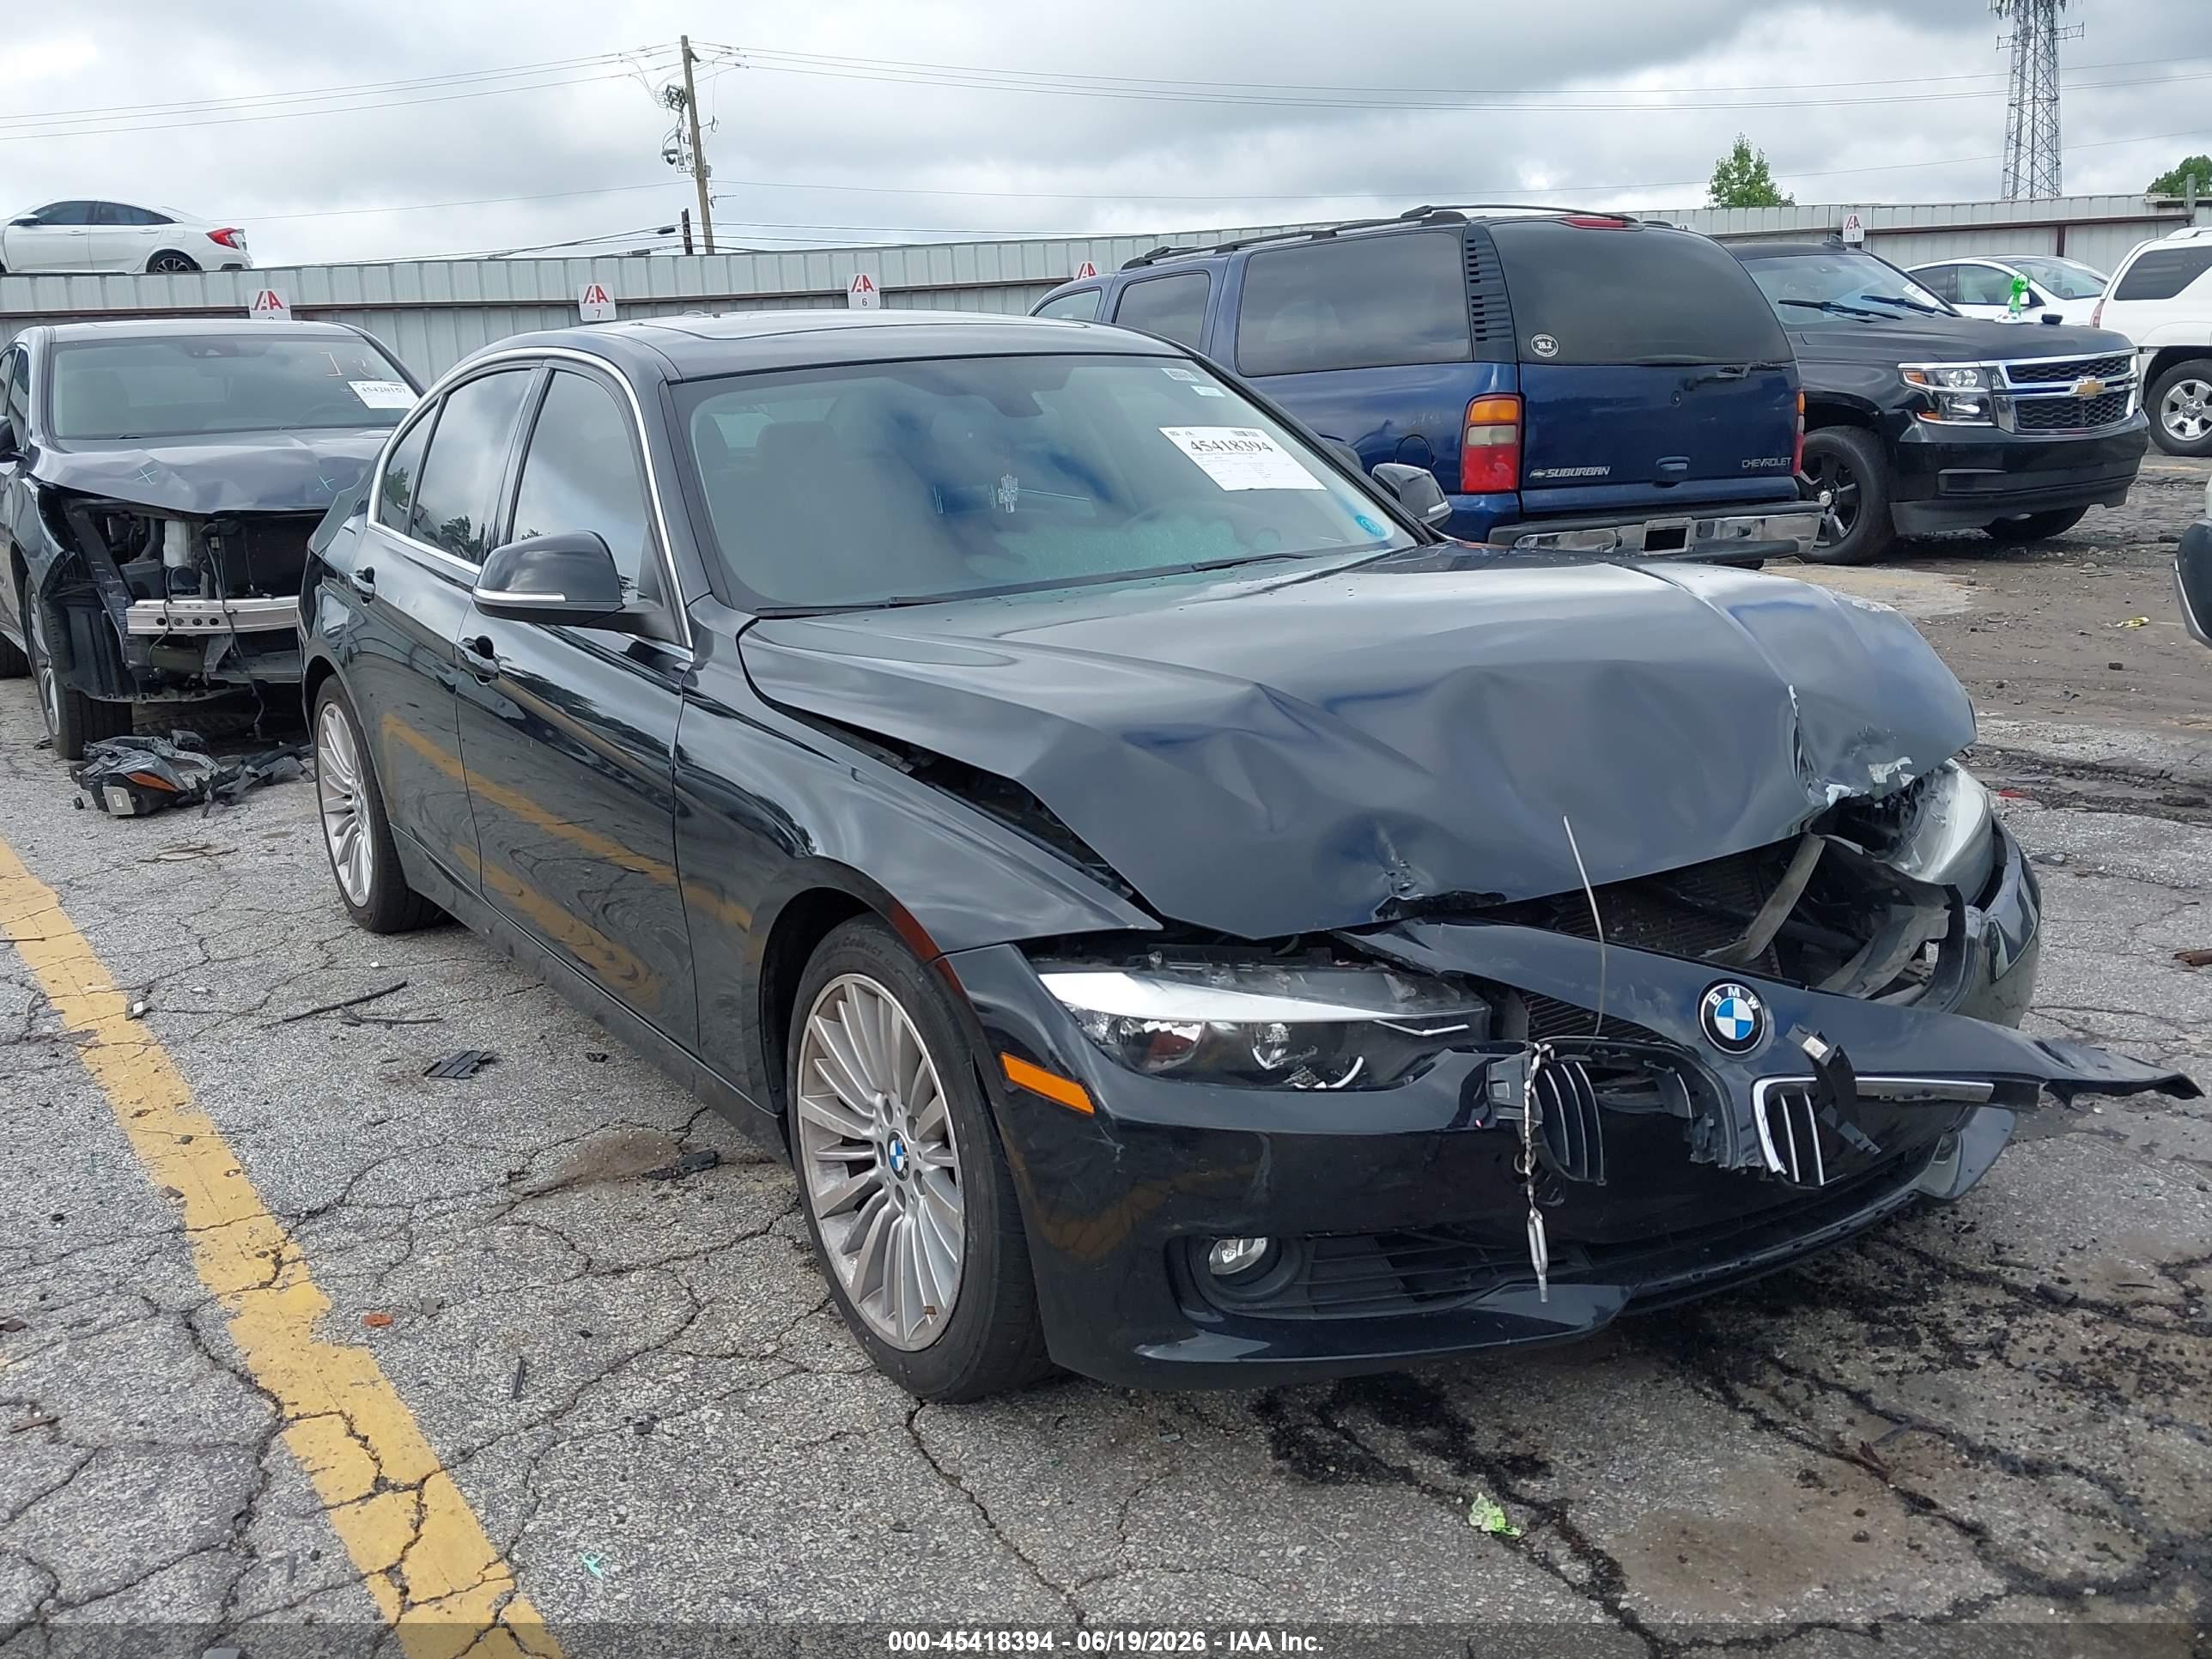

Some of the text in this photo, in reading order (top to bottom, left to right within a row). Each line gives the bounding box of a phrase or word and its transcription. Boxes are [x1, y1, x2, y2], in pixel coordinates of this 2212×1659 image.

[851, 274, 875, 292] IAA
[253, 289, 283, 310] IAA
[582, 284, 611, 304] IAA
[861, 297, 867, 307] 6
[594, 309, 601, 319] 7
[1190, 439, 1274, 453] 45418394
[1741, 457, 1792, 468] CHEVROLET
[1546, 465, 1611, 478] SUBURBAN
[1708, 987, 1760, 1012] BMW
